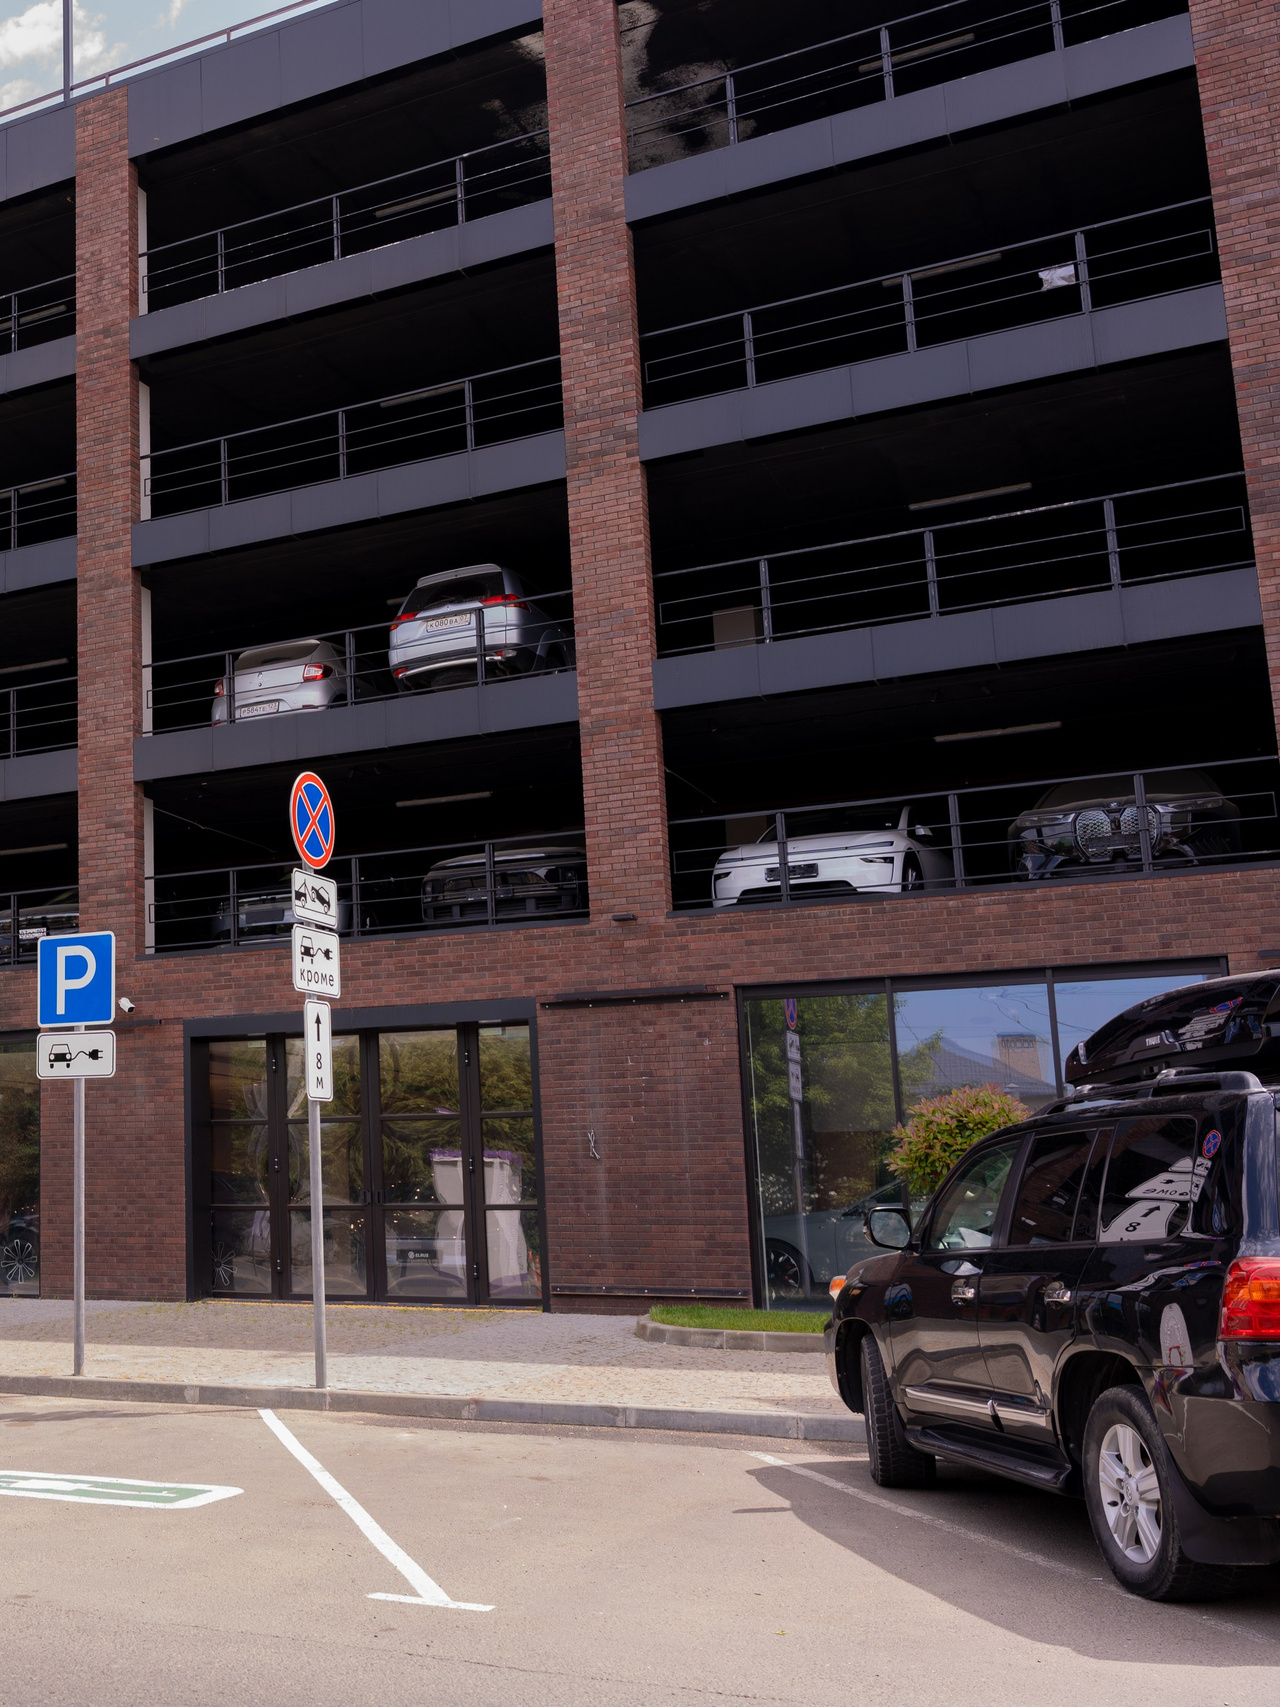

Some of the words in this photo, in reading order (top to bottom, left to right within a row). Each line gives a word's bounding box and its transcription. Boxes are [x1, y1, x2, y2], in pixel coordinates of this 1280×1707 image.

[56, 945, 97, 1015] P
[300, 967, 335, 987] кроме
[316, 1052, 323, 1070] 8
